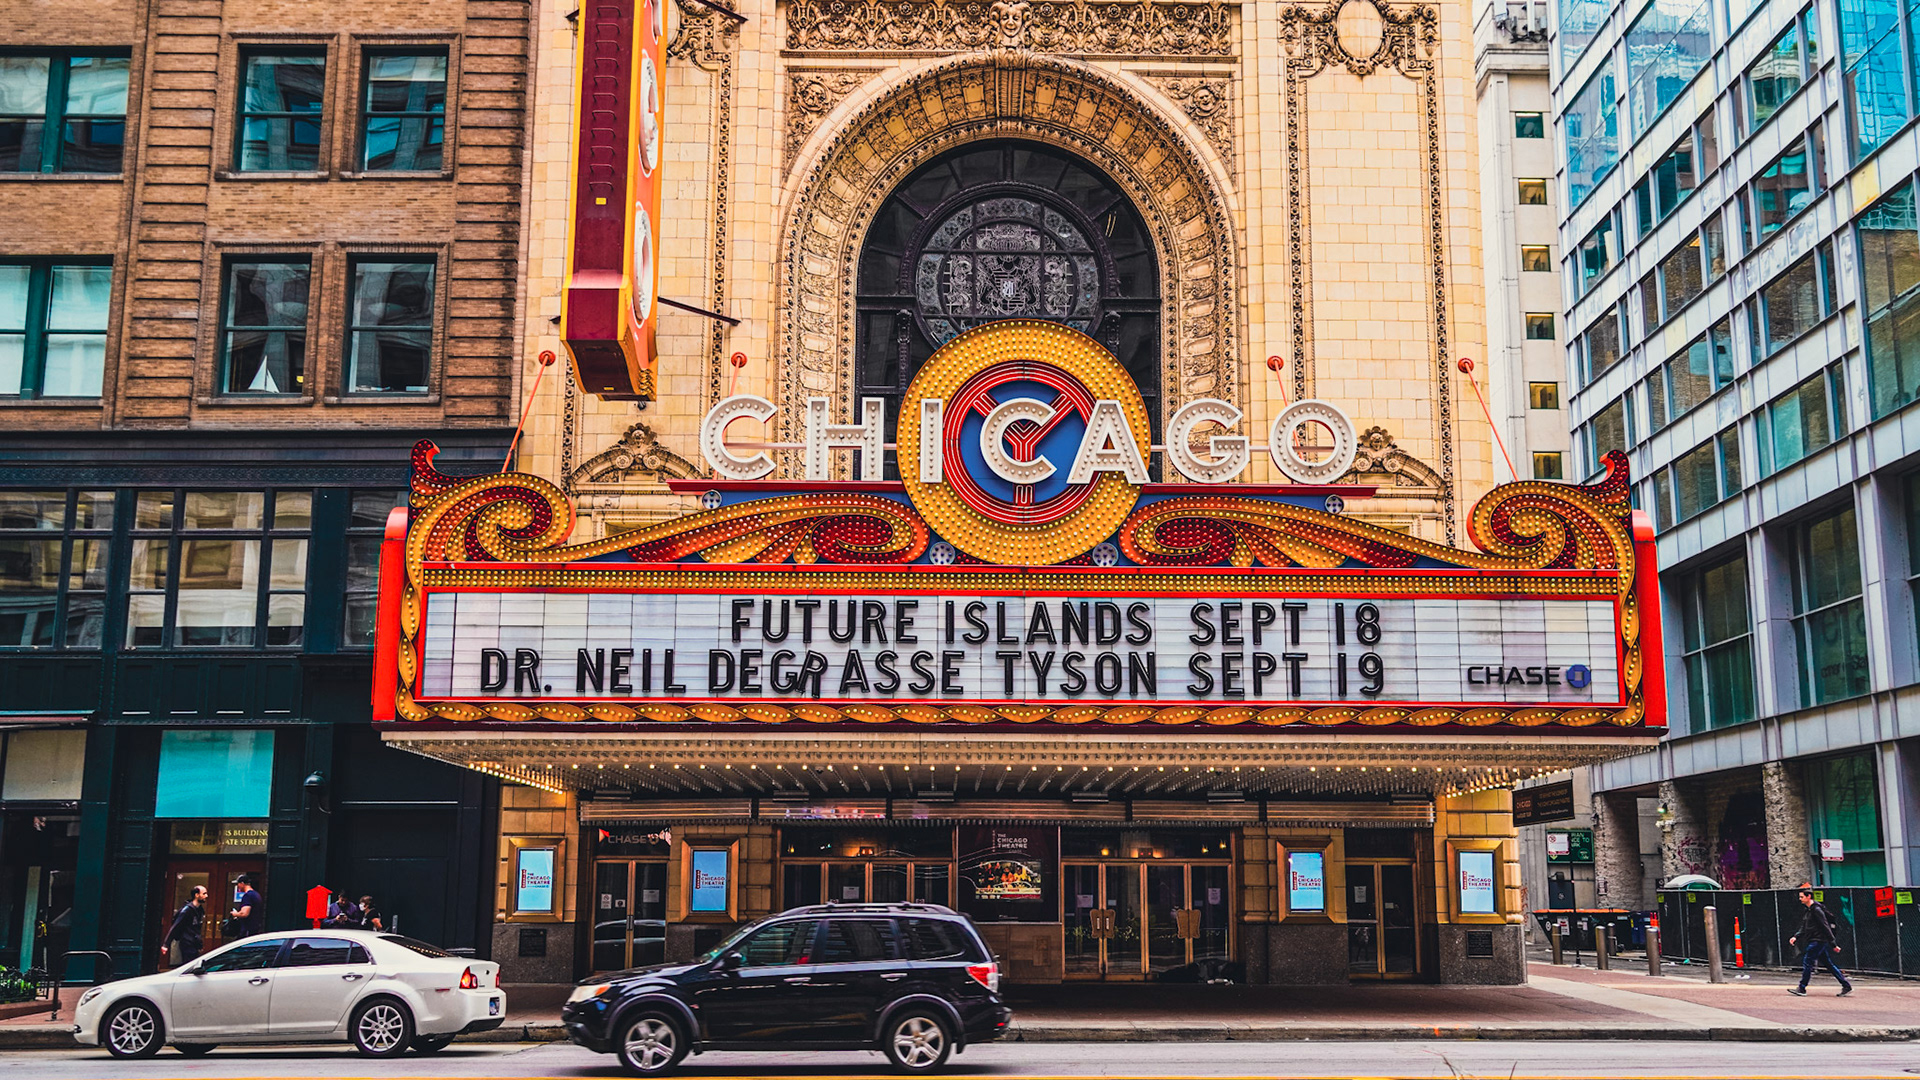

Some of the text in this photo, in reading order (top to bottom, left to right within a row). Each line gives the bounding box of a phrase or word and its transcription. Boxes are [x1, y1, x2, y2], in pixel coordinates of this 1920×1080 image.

[700, 395, 1358, 485] CHICAGO
[731, 598, 1382, 646] FUTURE ISLANDS SEPT 18
[481, 647, 1384, 699] DR. NEIL DEGRASSE TYSON SEPT 19
[1467, 666, 1561, 685] CHASE
[240, 838, 267, 846] STREET
[607, 834, 647, 844] CHASE
